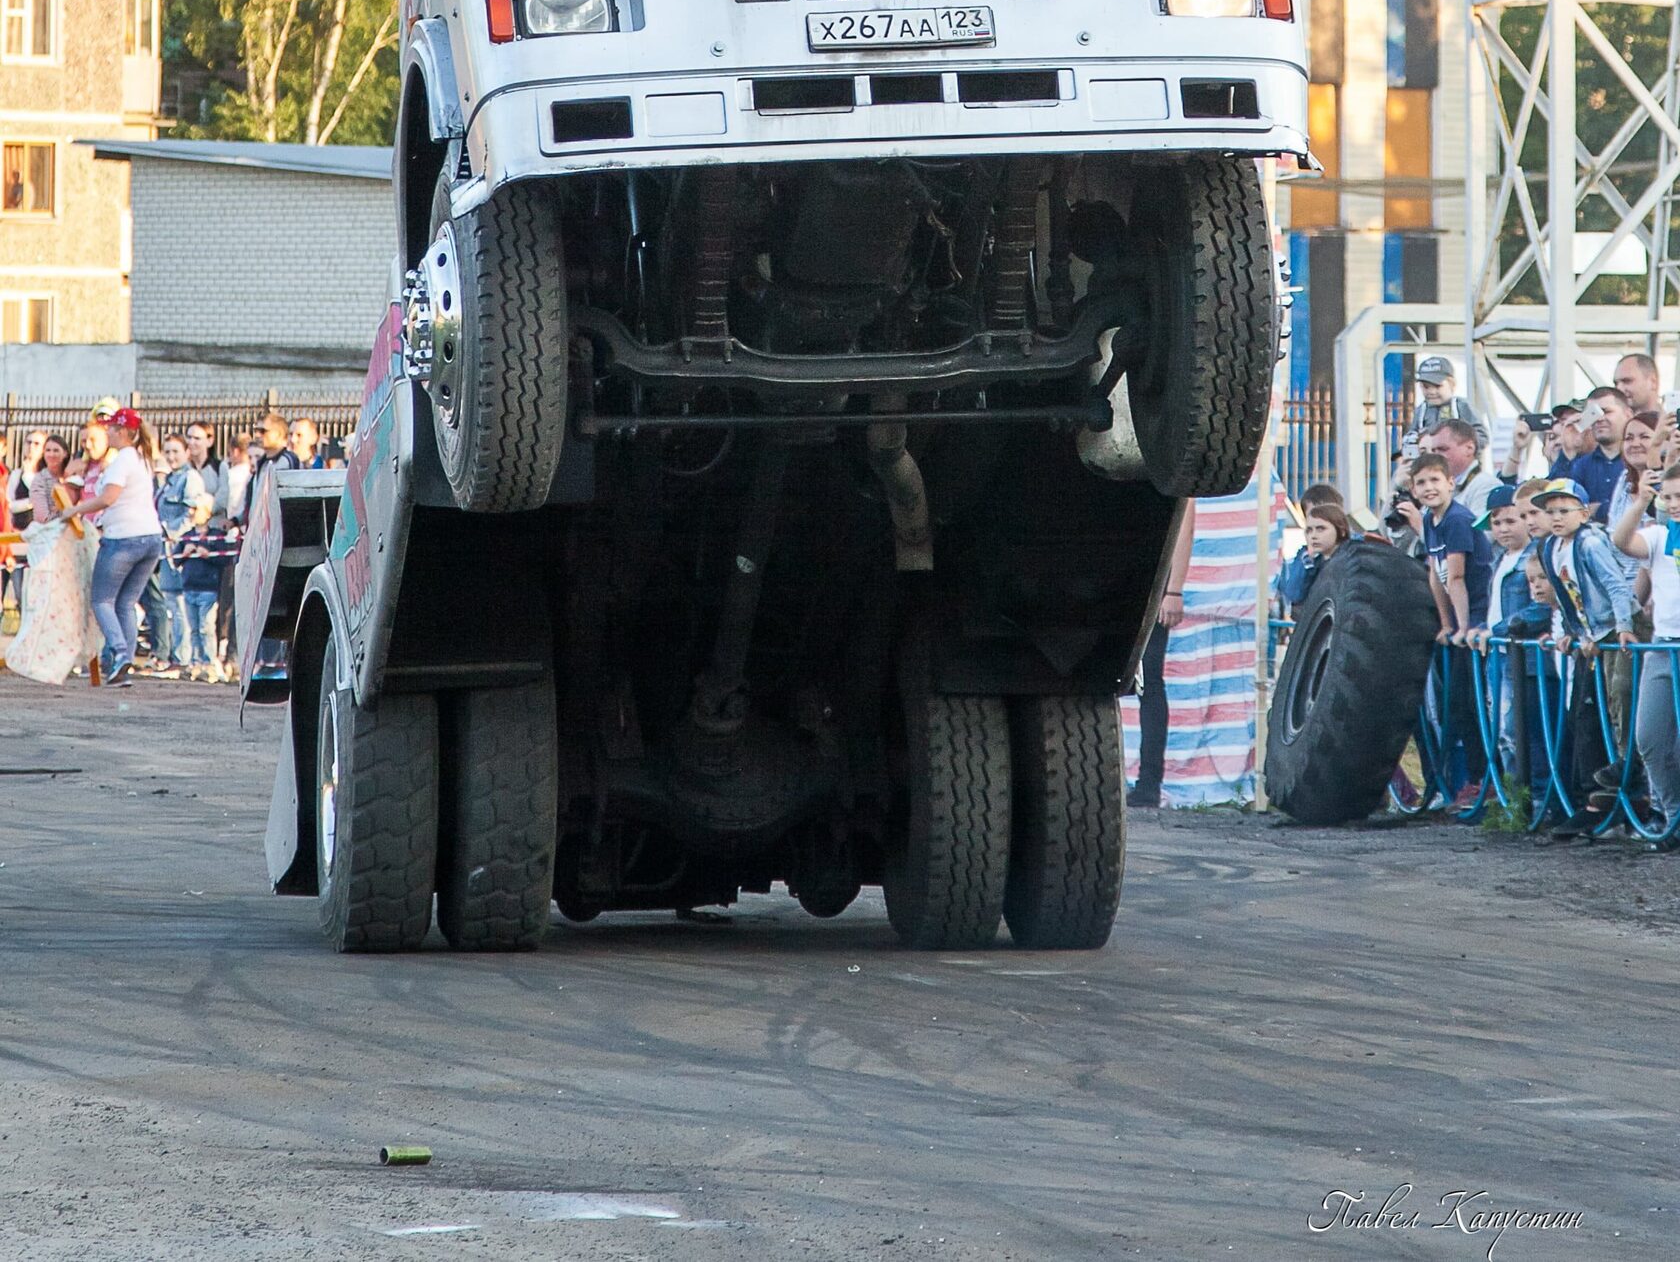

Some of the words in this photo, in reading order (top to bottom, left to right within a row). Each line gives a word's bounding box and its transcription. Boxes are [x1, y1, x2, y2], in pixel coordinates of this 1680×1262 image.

[820, 14, 935, 41] Х267АА
[940, 9, 984, 29] 123
[952, 29, 974, 37] RUS
